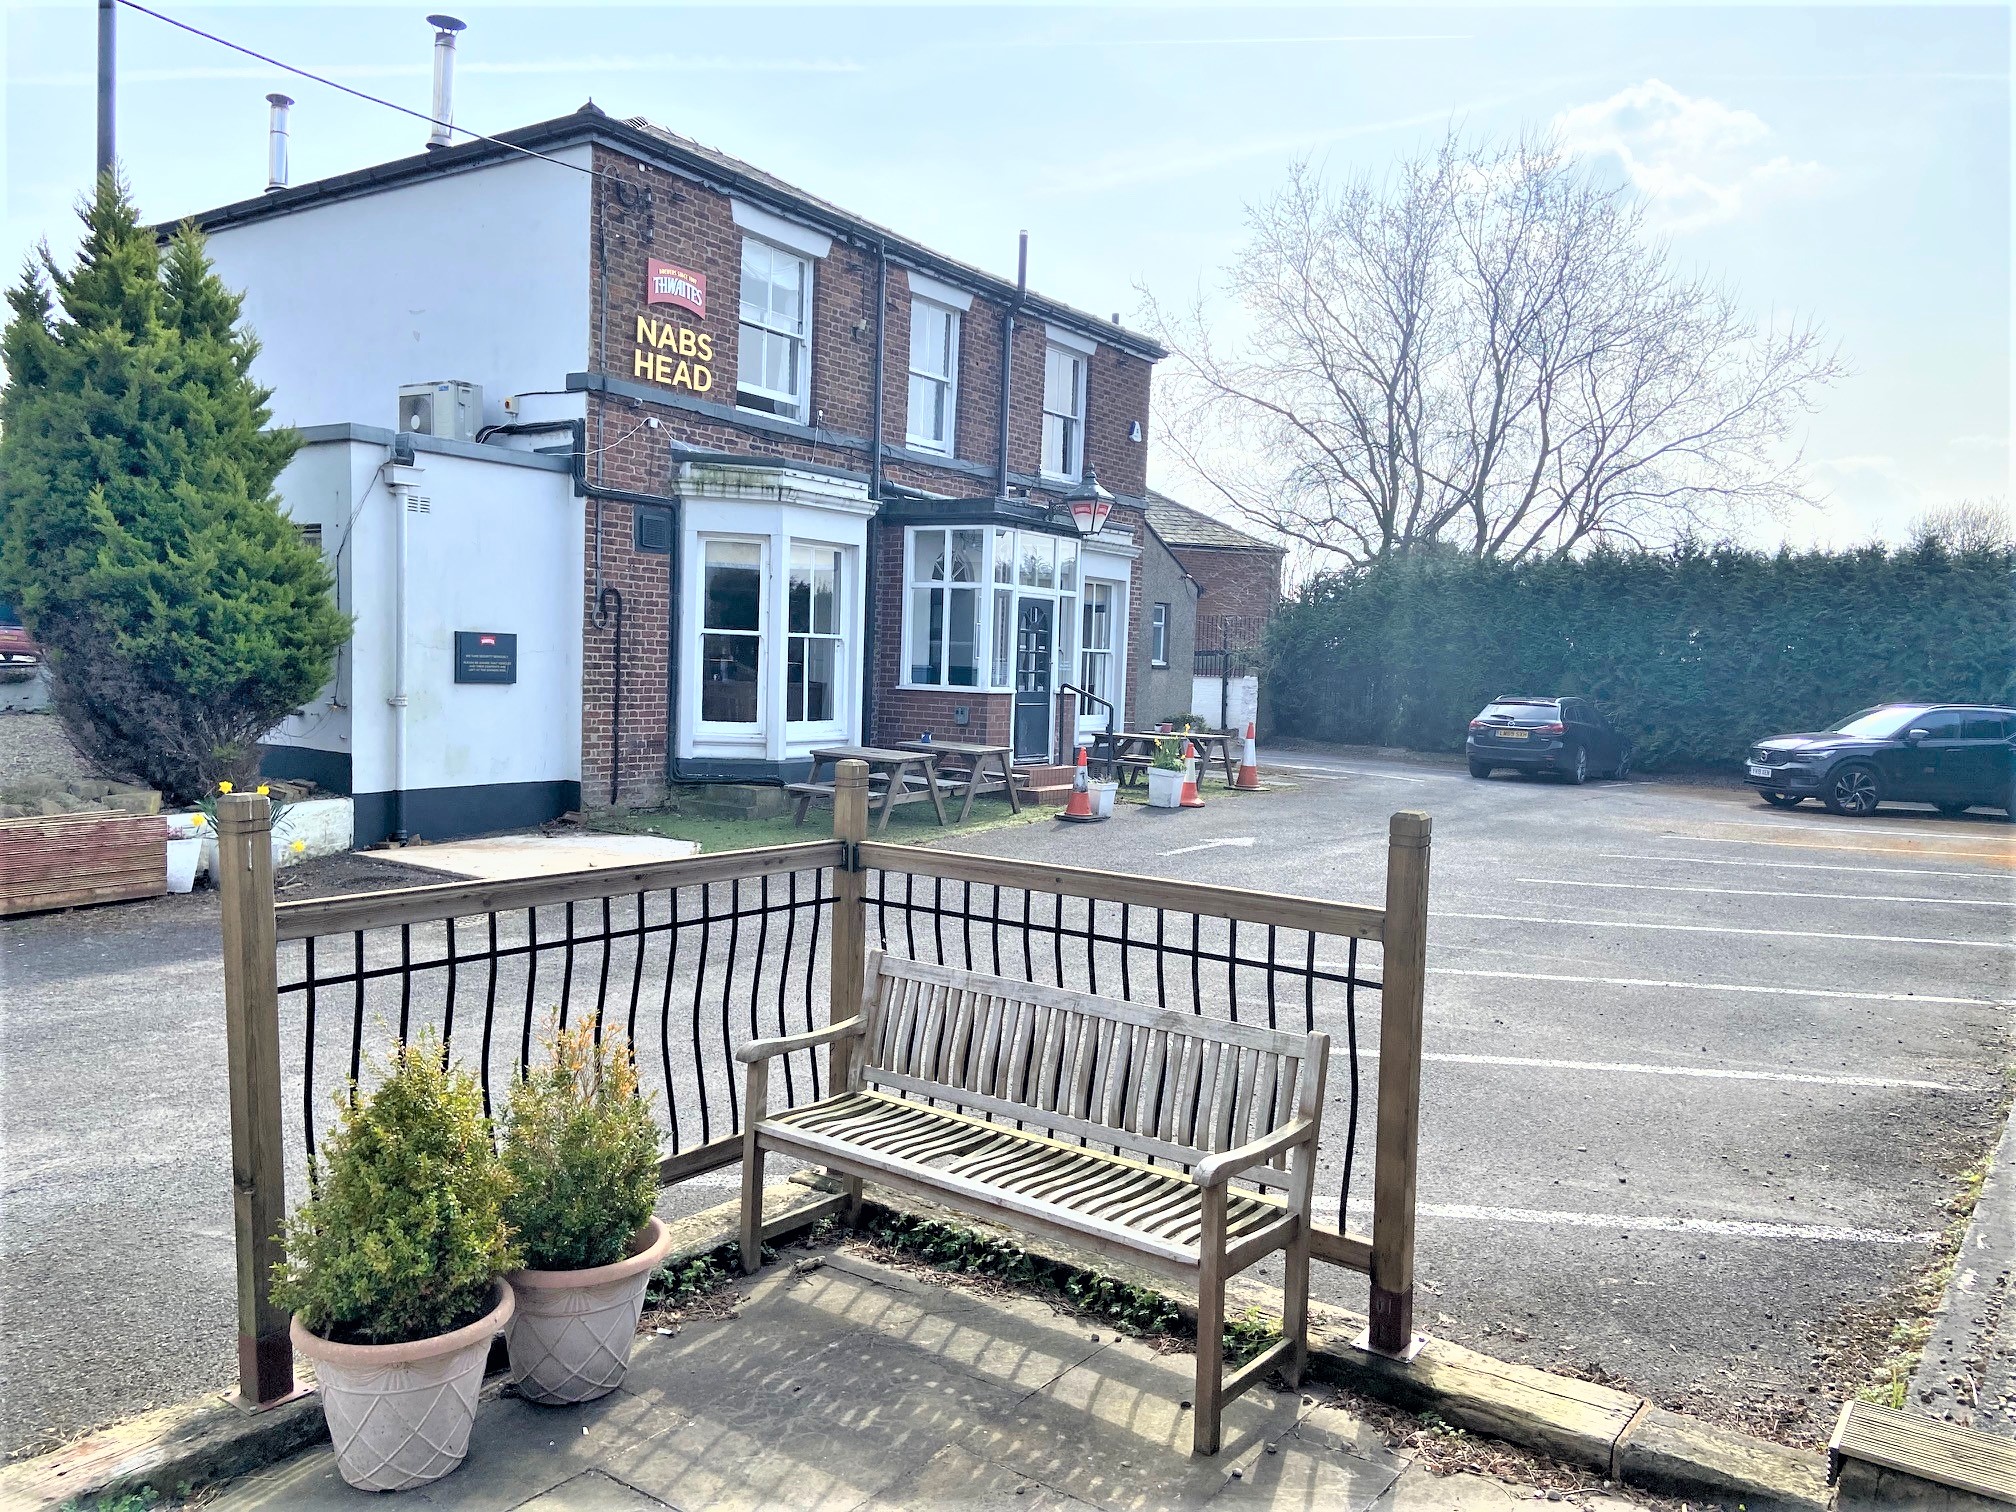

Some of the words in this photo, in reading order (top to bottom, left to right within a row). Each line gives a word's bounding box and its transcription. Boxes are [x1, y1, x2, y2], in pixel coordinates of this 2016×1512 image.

[652, 276, 703, 306] THWAITES
[636, 314, 713, 362] NABS
[634, 348, 712, 392] HEAD
